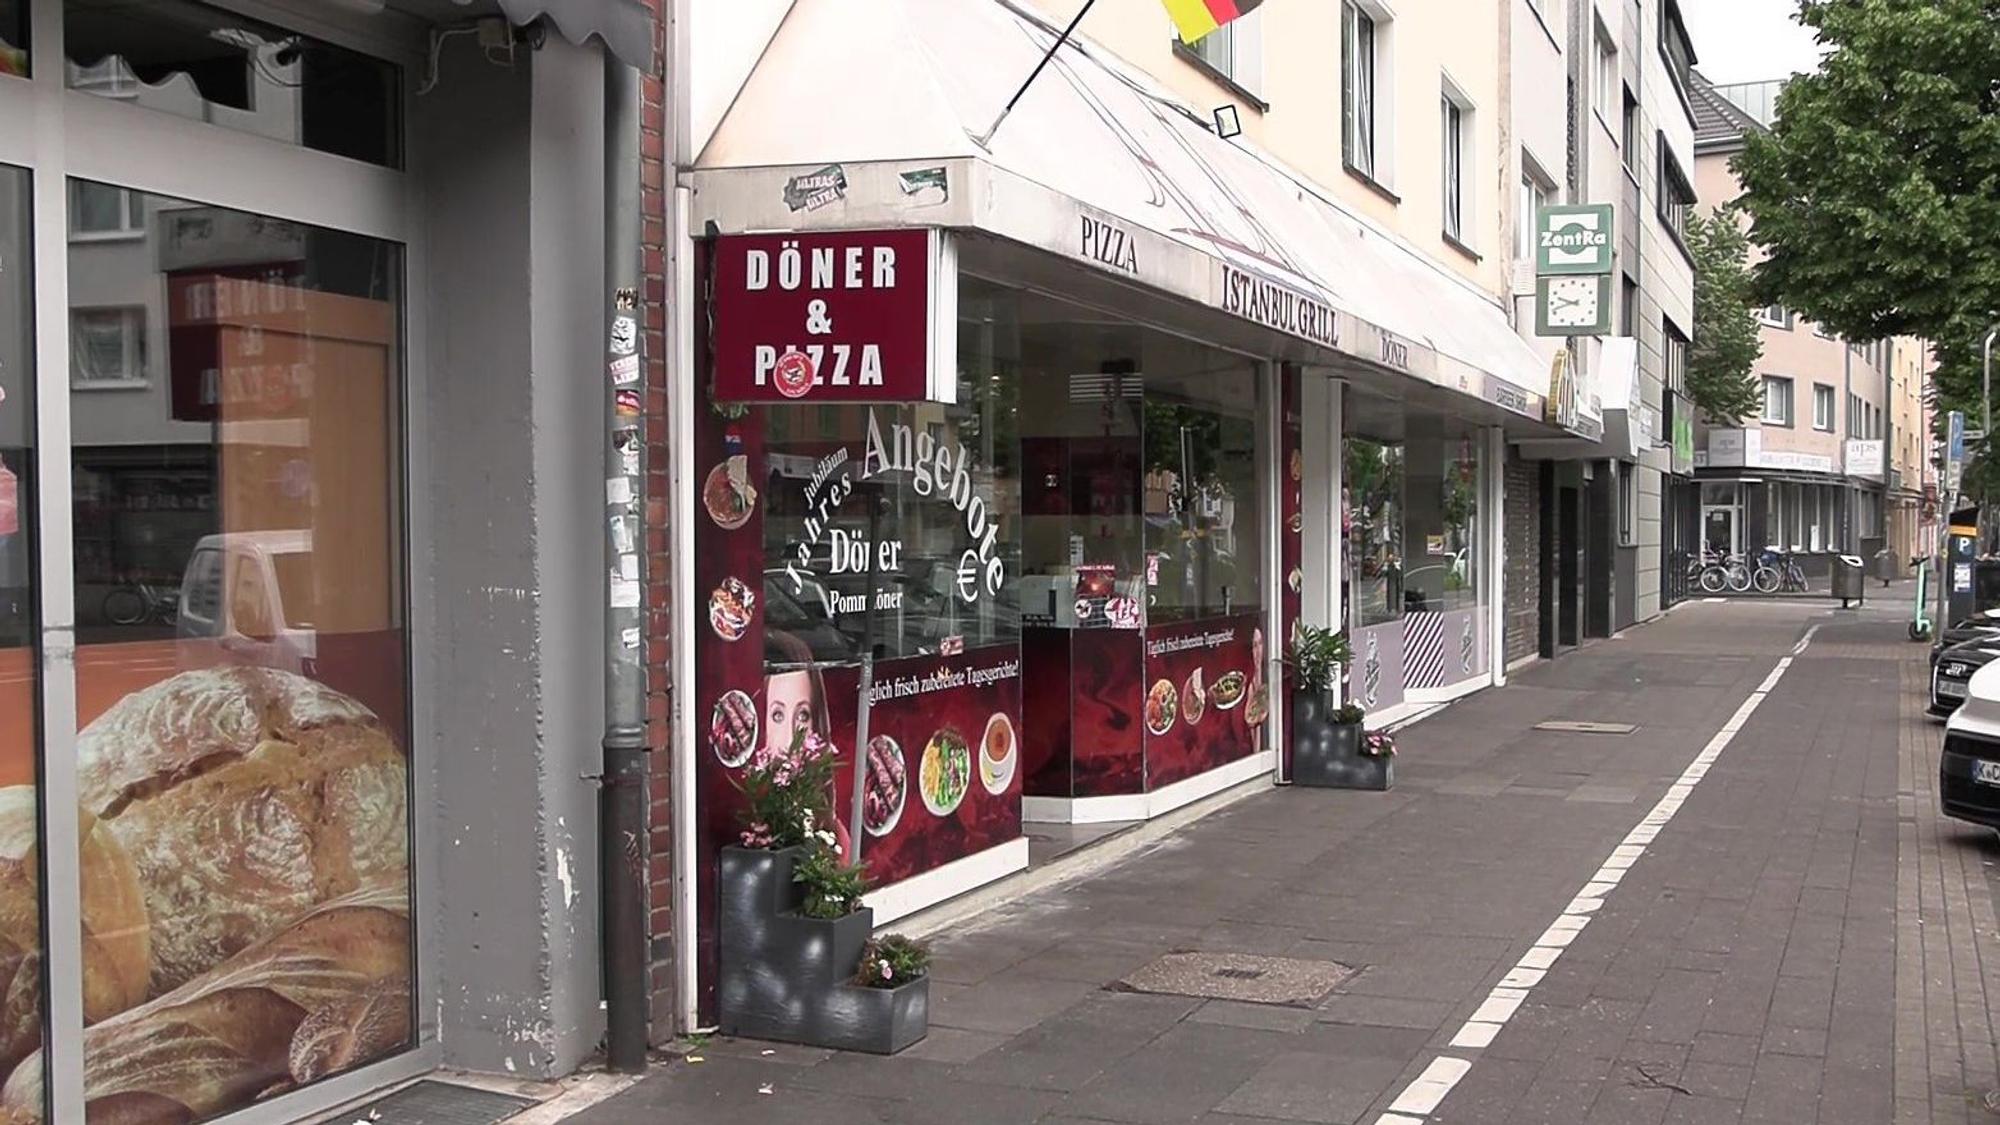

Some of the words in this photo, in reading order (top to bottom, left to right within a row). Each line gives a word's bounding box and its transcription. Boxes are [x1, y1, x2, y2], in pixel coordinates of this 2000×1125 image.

[1081, 215, 1138, 275] PIZZA
[1540, 231, 1607, 247] ZentRa
[746, 241, 896, 291] DÖNER
[806, 299, 833, 334] &
[1222, 266, 1296, 332] ISTANBUL
[1298, 296, 1339, 346] GRILL
[755, 344, 884, 386] PZZA
[1381, 331, 1409, 371] DÖNER
[785, 472, 851, 595] Jahres
[862, 406, 1004, 596] Angebote
[802, 446, 849, 510] jubiläum
[1959, 537, 1970, 553] P
[956, 549, 978, 602] €
[894, 675, 920, 698] frisch
